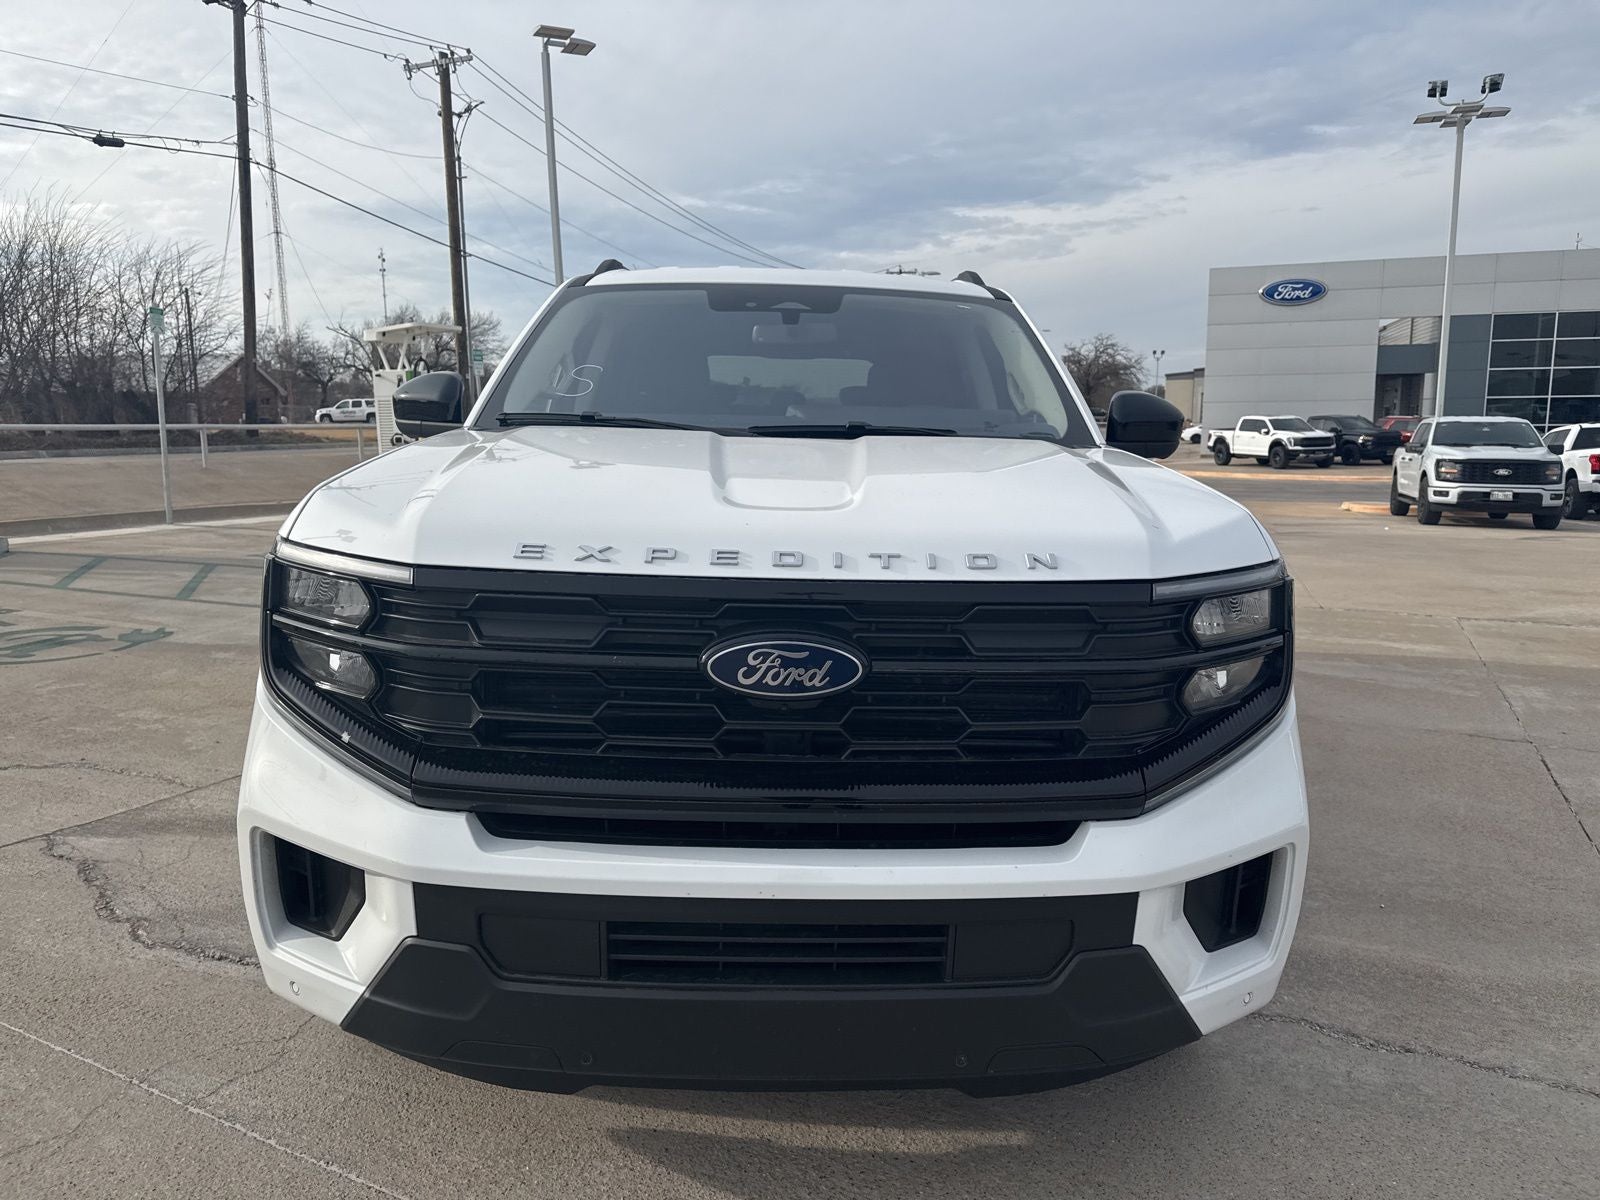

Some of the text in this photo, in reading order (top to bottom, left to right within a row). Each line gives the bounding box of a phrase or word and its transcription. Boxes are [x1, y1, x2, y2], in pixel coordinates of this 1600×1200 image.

[1274, 284, 1313, 299] Ford
[555, 364, 604, 397] S
[512, 542, 1059, 570] EXPEDITION
[737, 648, 833, 687] Ford
